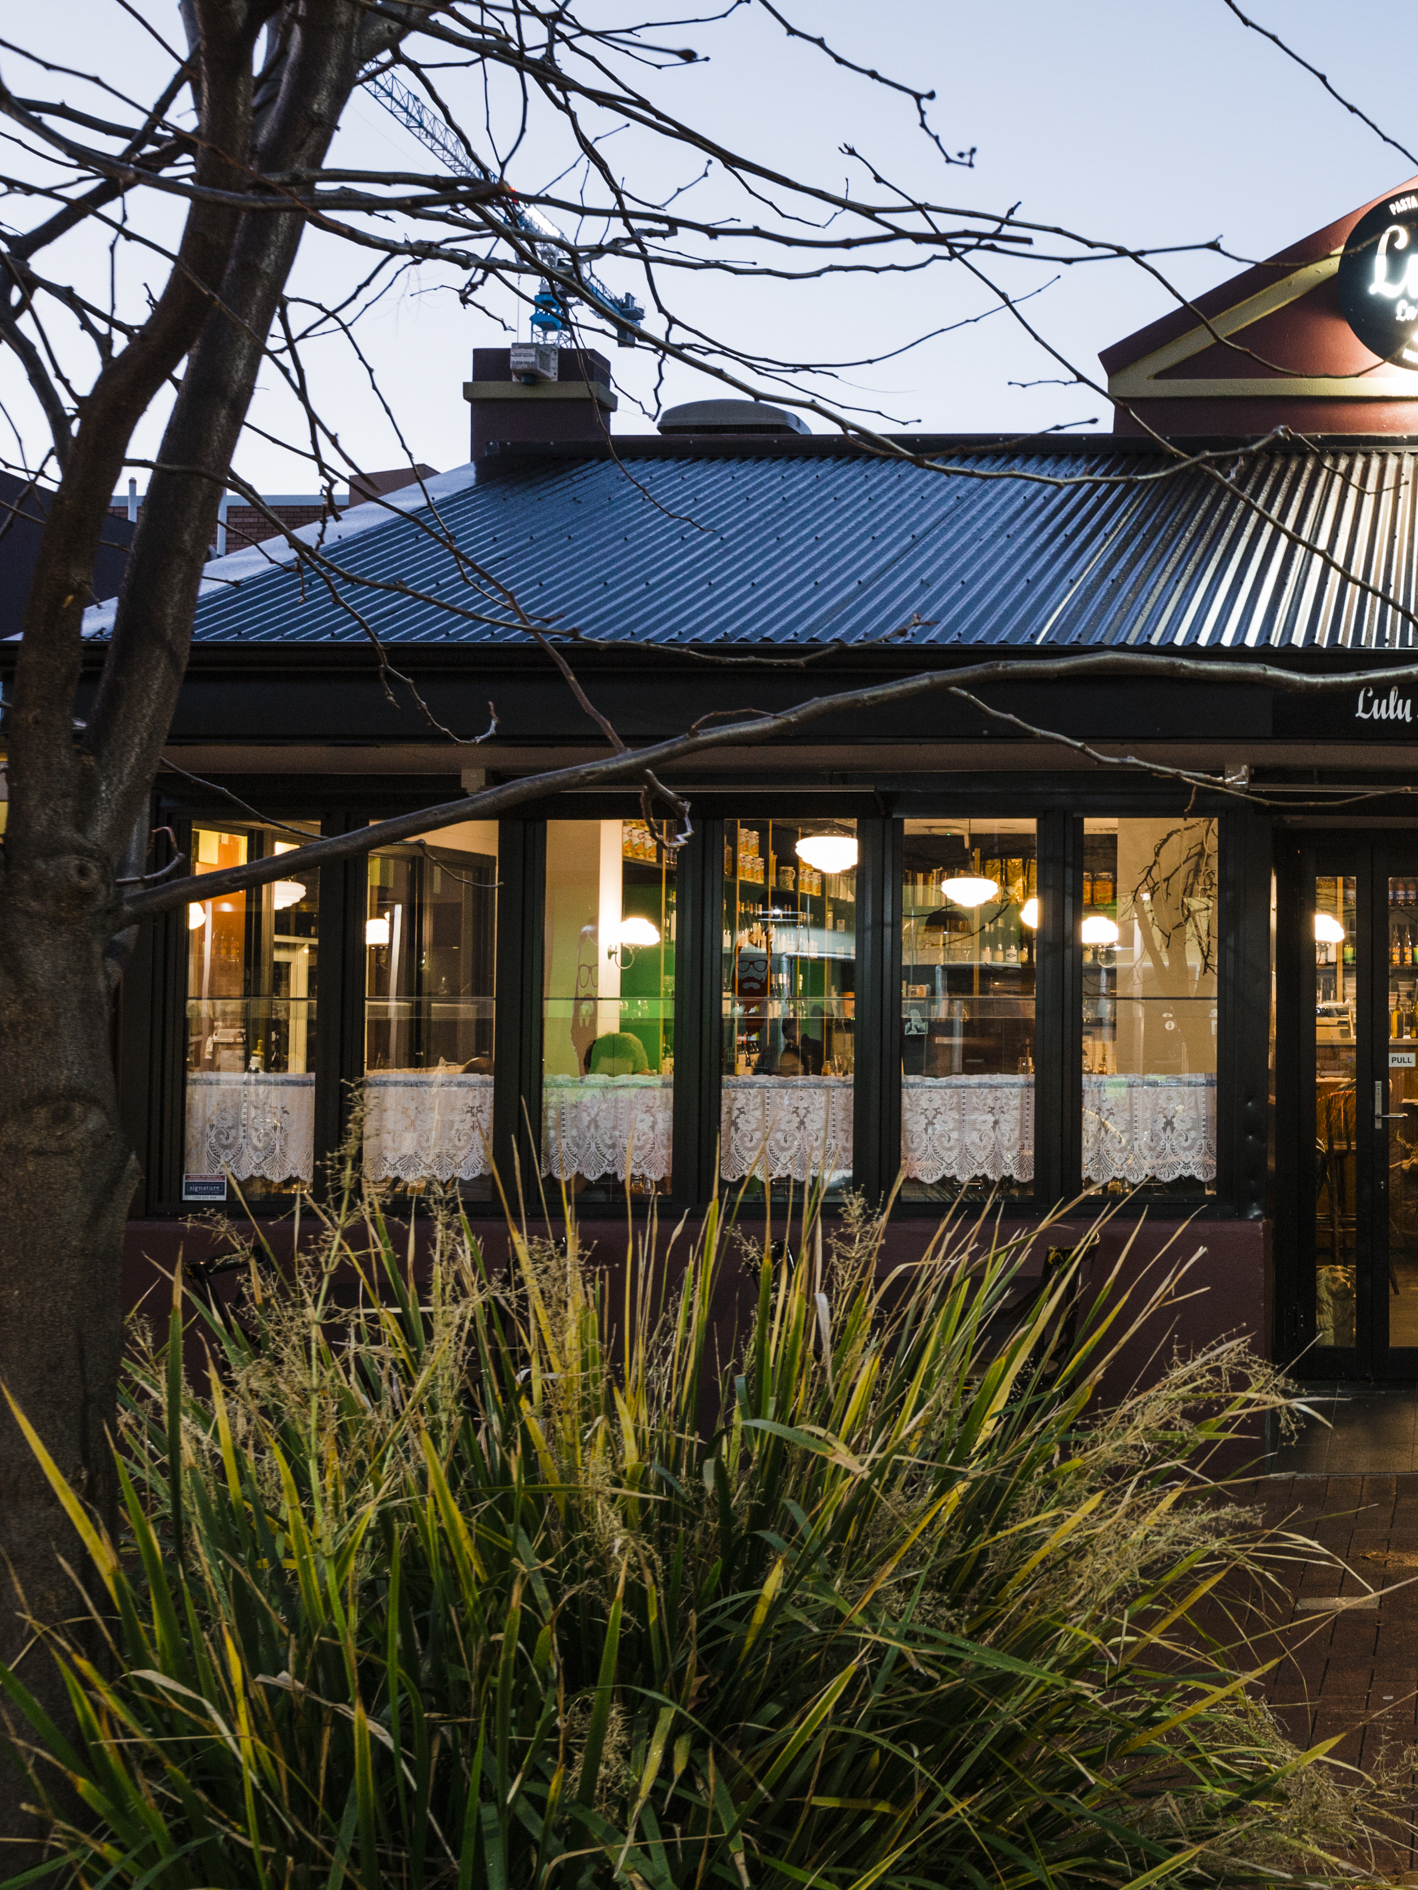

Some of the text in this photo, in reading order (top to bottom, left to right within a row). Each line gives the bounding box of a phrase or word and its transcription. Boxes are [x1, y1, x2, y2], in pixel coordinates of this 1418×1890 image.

[1389, 195, 1418, 216] PASTA
[1396, 299, 1417, 321] La
[1355, 685, 1412, 723] Lulu
[1391, 1056, 1413, 1064] PULL
